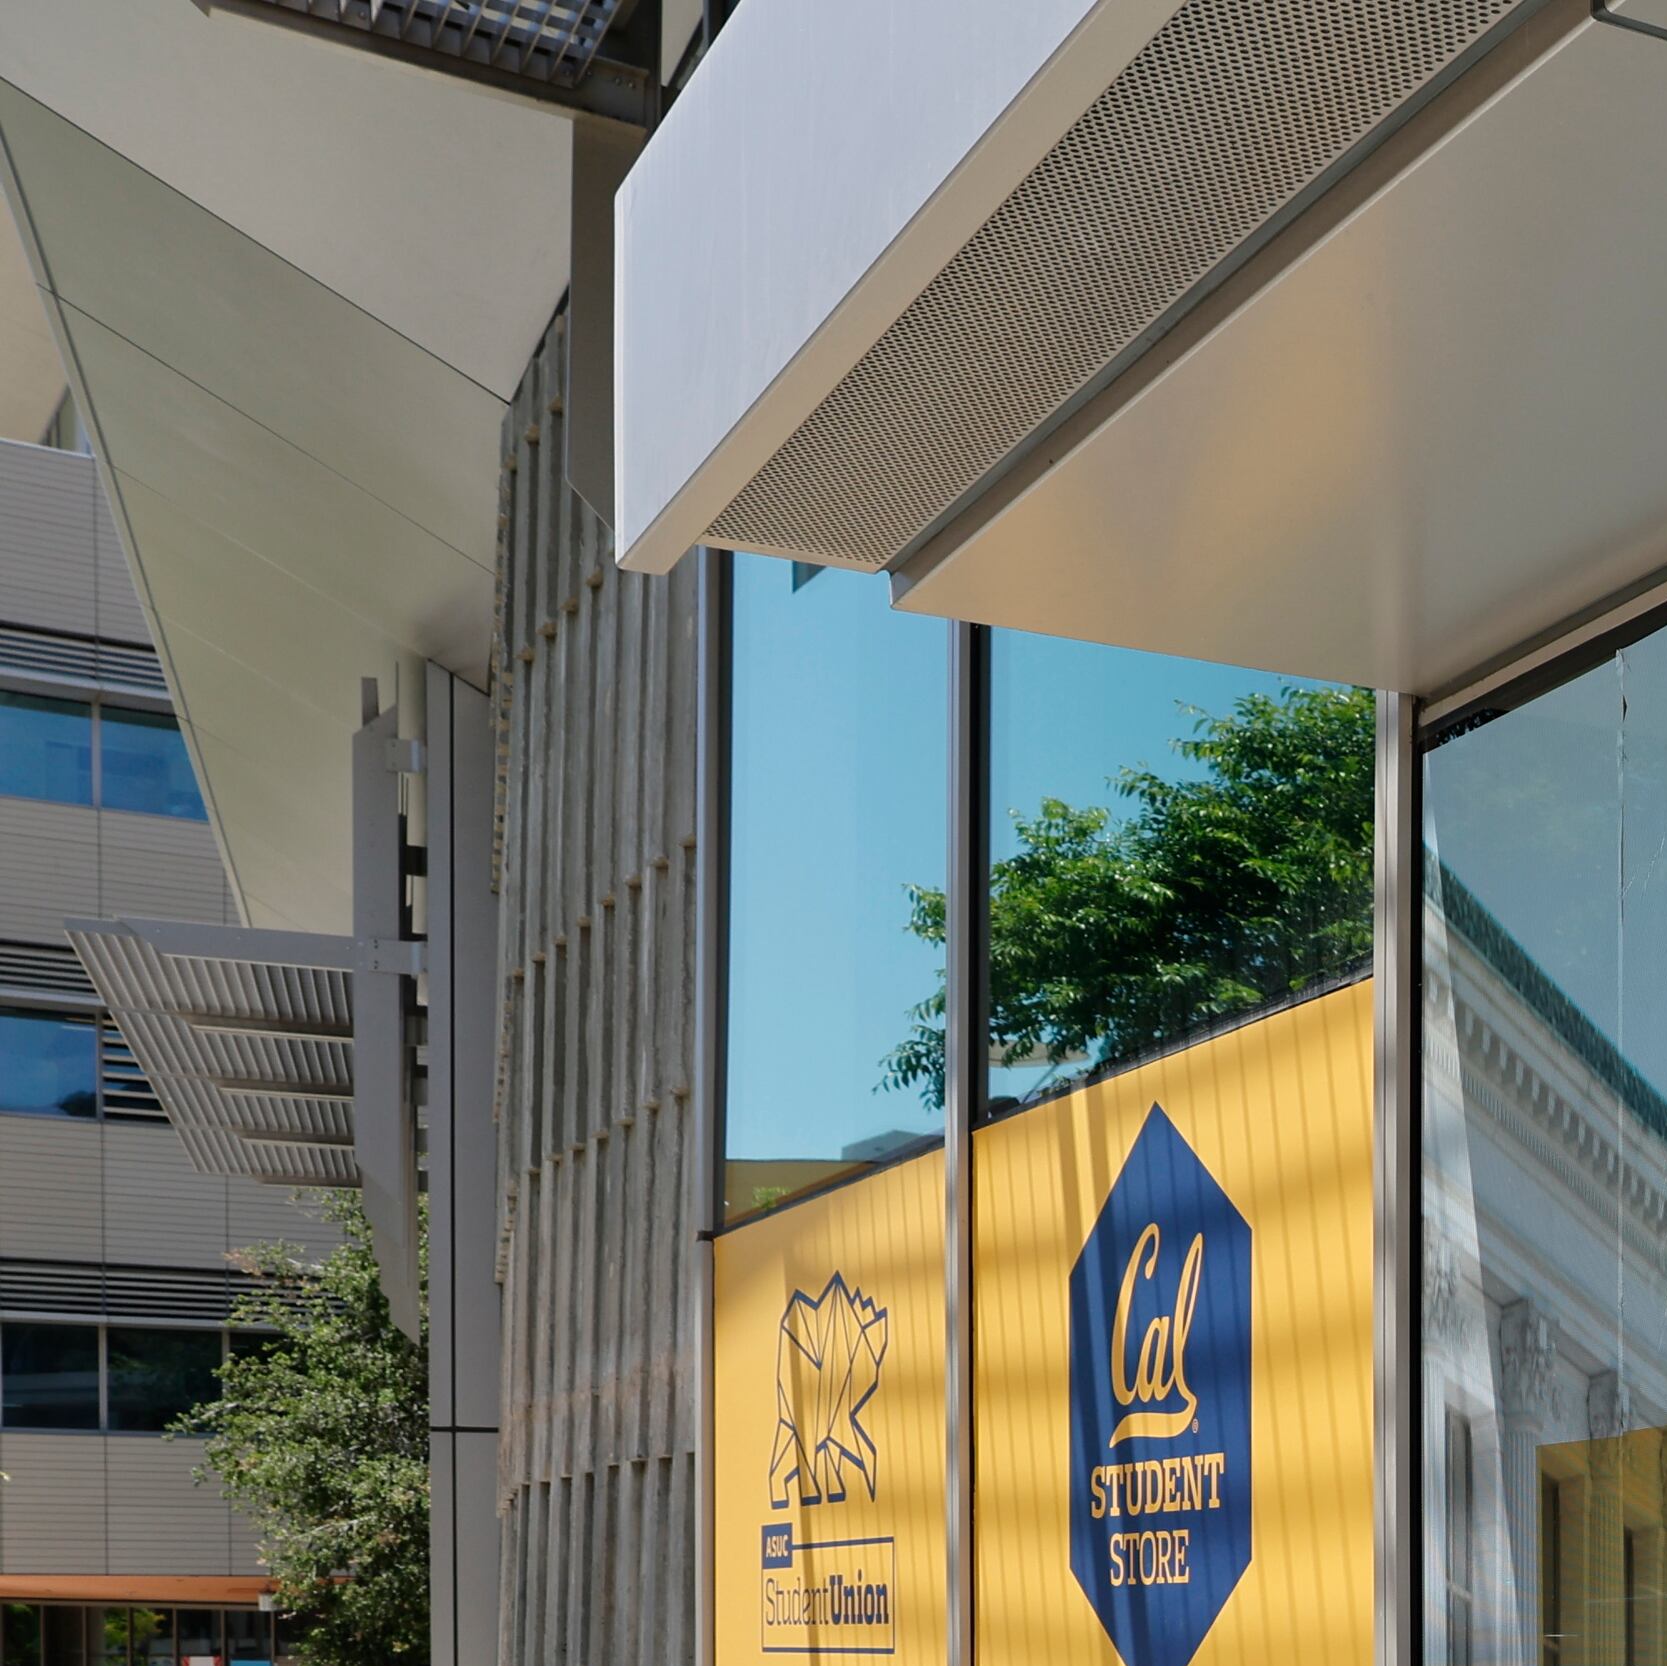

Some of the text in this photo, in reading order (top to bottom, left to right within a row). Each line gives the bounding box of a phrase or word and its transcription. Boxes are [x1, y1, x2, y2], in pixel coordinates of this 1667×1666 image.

[1108, 1222, 1204, 1449] Cal
[1090, 1451, 1225, 1519] STUDENT
[766, 1534, 788, 1558] ASUC
[1108, 1528, 1190, 1587] STORE
